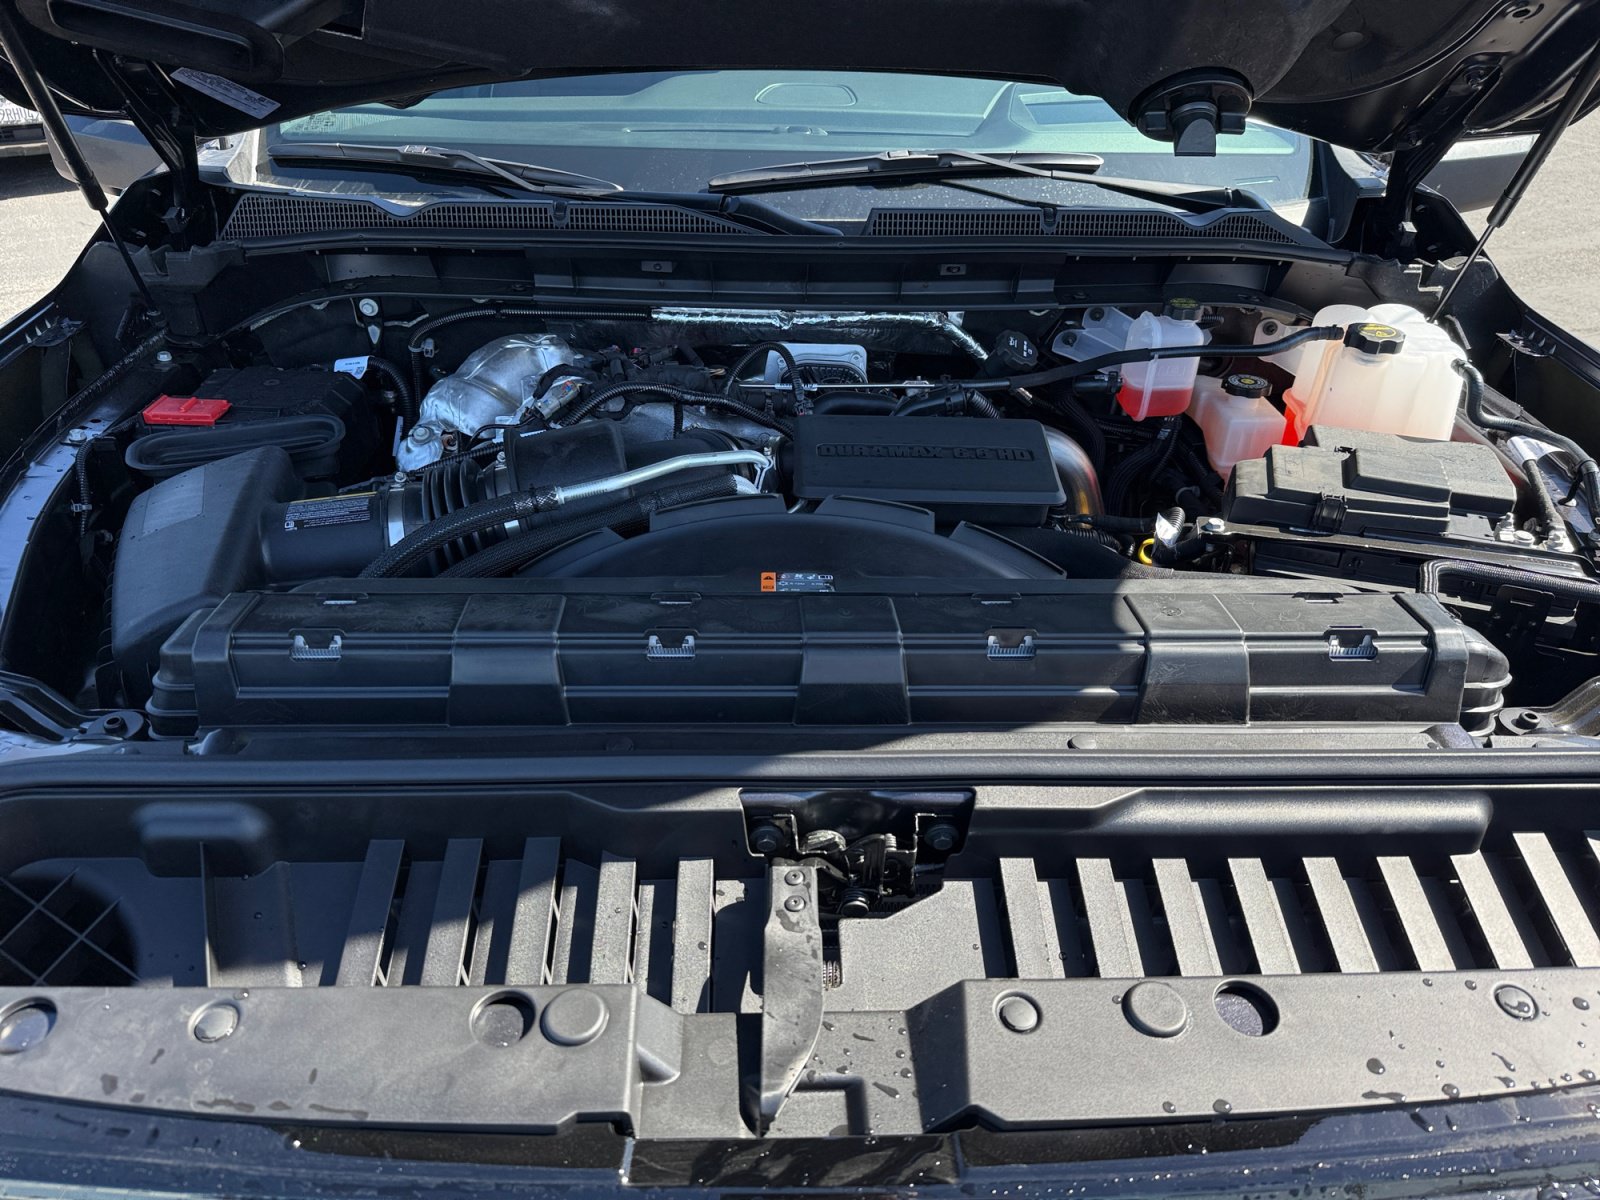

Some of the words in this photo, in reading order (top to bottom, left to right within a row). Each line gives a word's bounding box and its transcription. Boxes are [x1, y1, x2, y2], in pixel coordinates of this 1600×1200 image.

[819, 444, 945, 459] DURAMAX
[953, 446, 991, 460] 6.6
[995, 447, 1035, 461] HD
